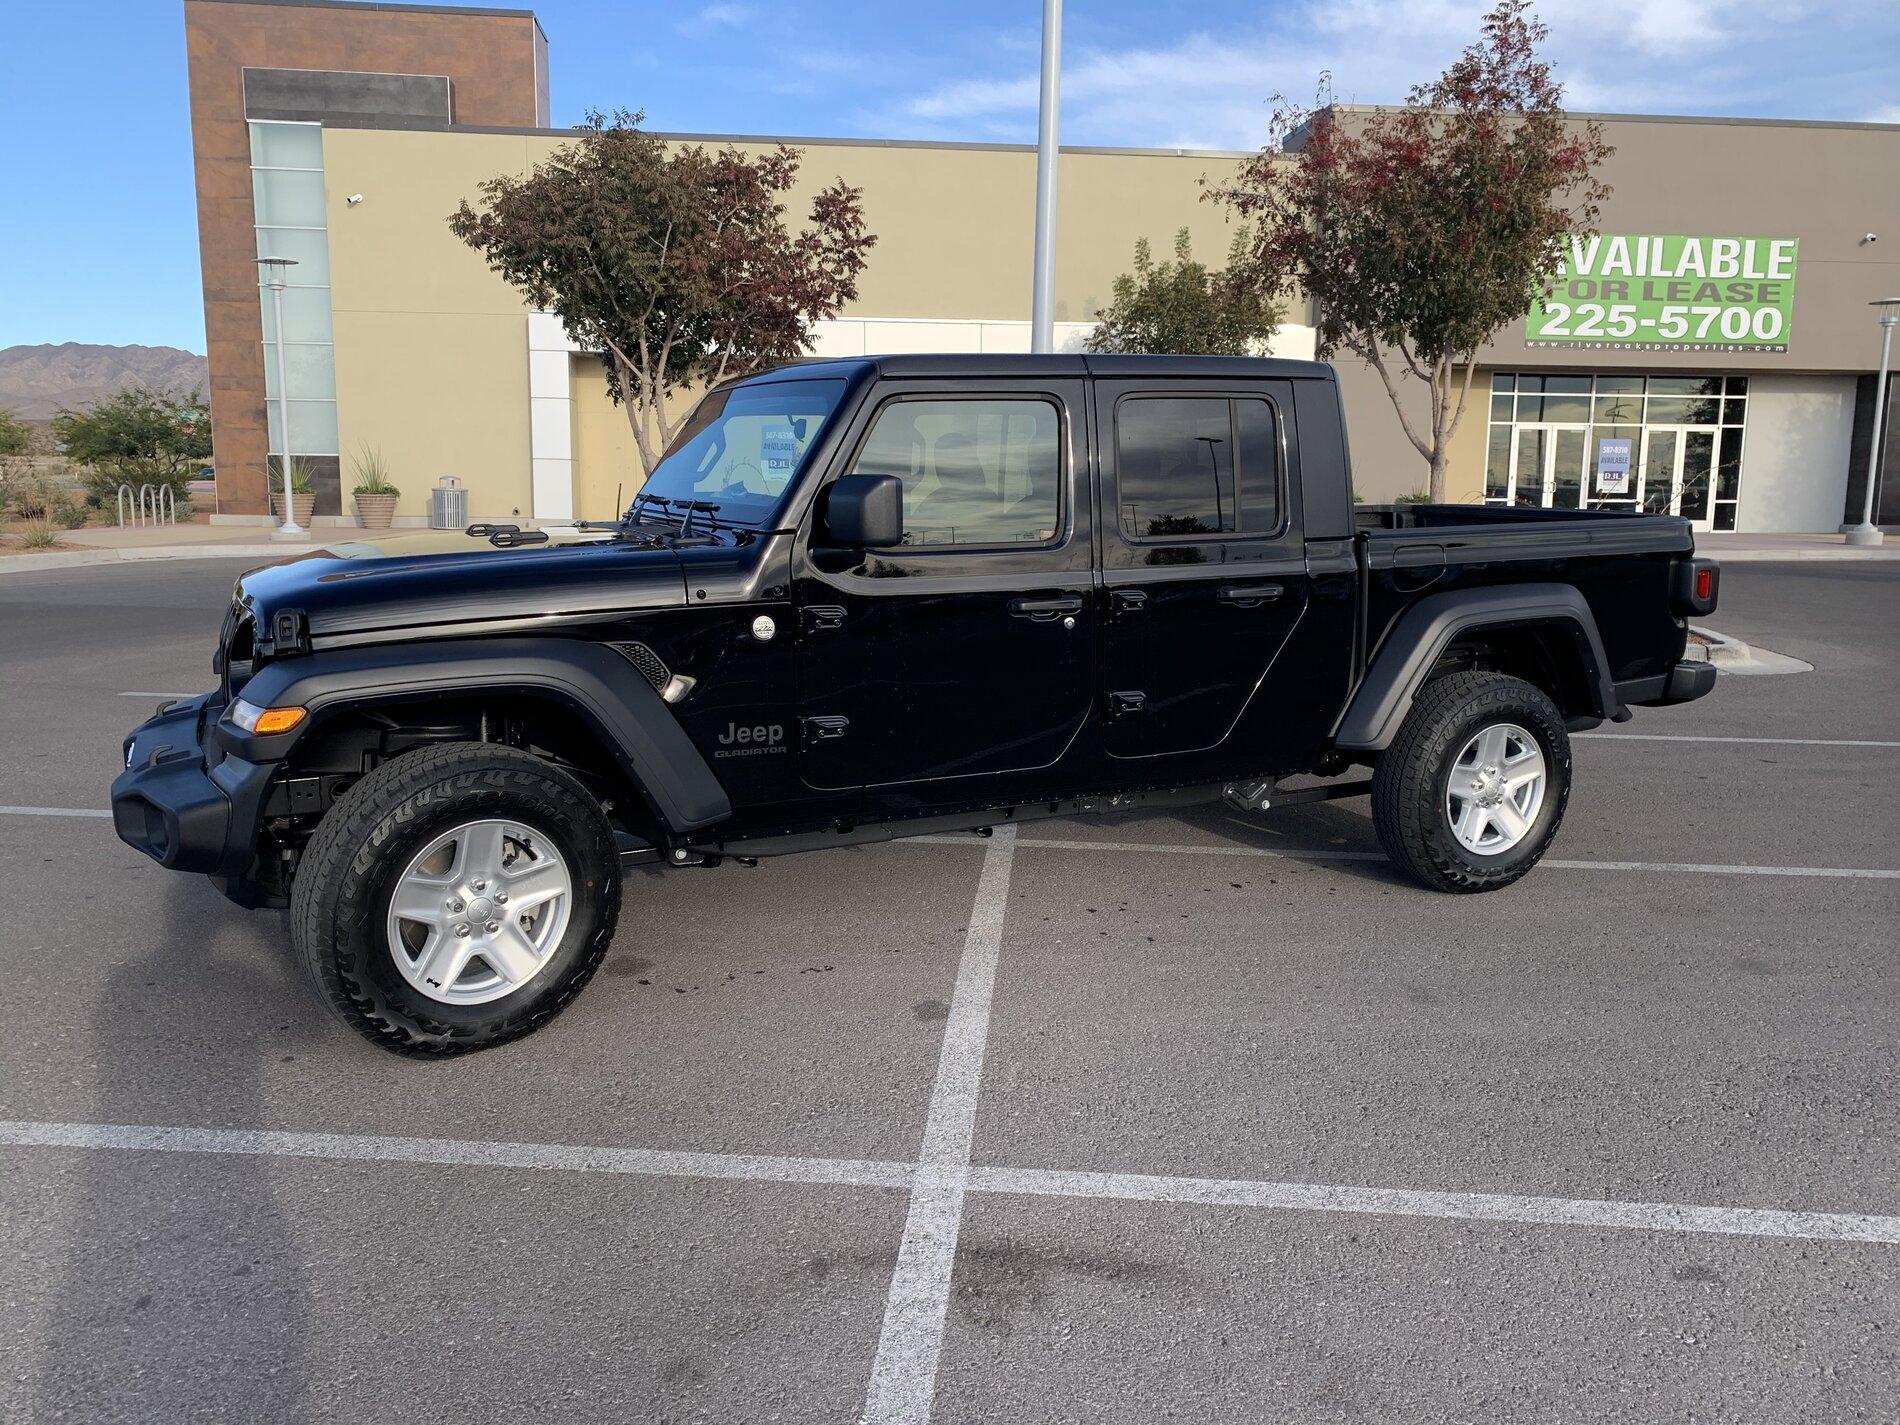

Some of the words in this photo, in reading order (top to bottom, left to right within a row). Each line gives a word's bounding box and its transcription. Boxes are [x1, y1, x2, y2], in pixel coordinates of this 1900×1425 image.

[1642, 280, 1782, 304] LEASE
[1538, 302, 1783, 340] 225-5700
[1601, 456, 1628, 464] AVAILABLE
[718, 723, 784, 745] Jeep
[715, 746, 787, 758] GLADIATOR
